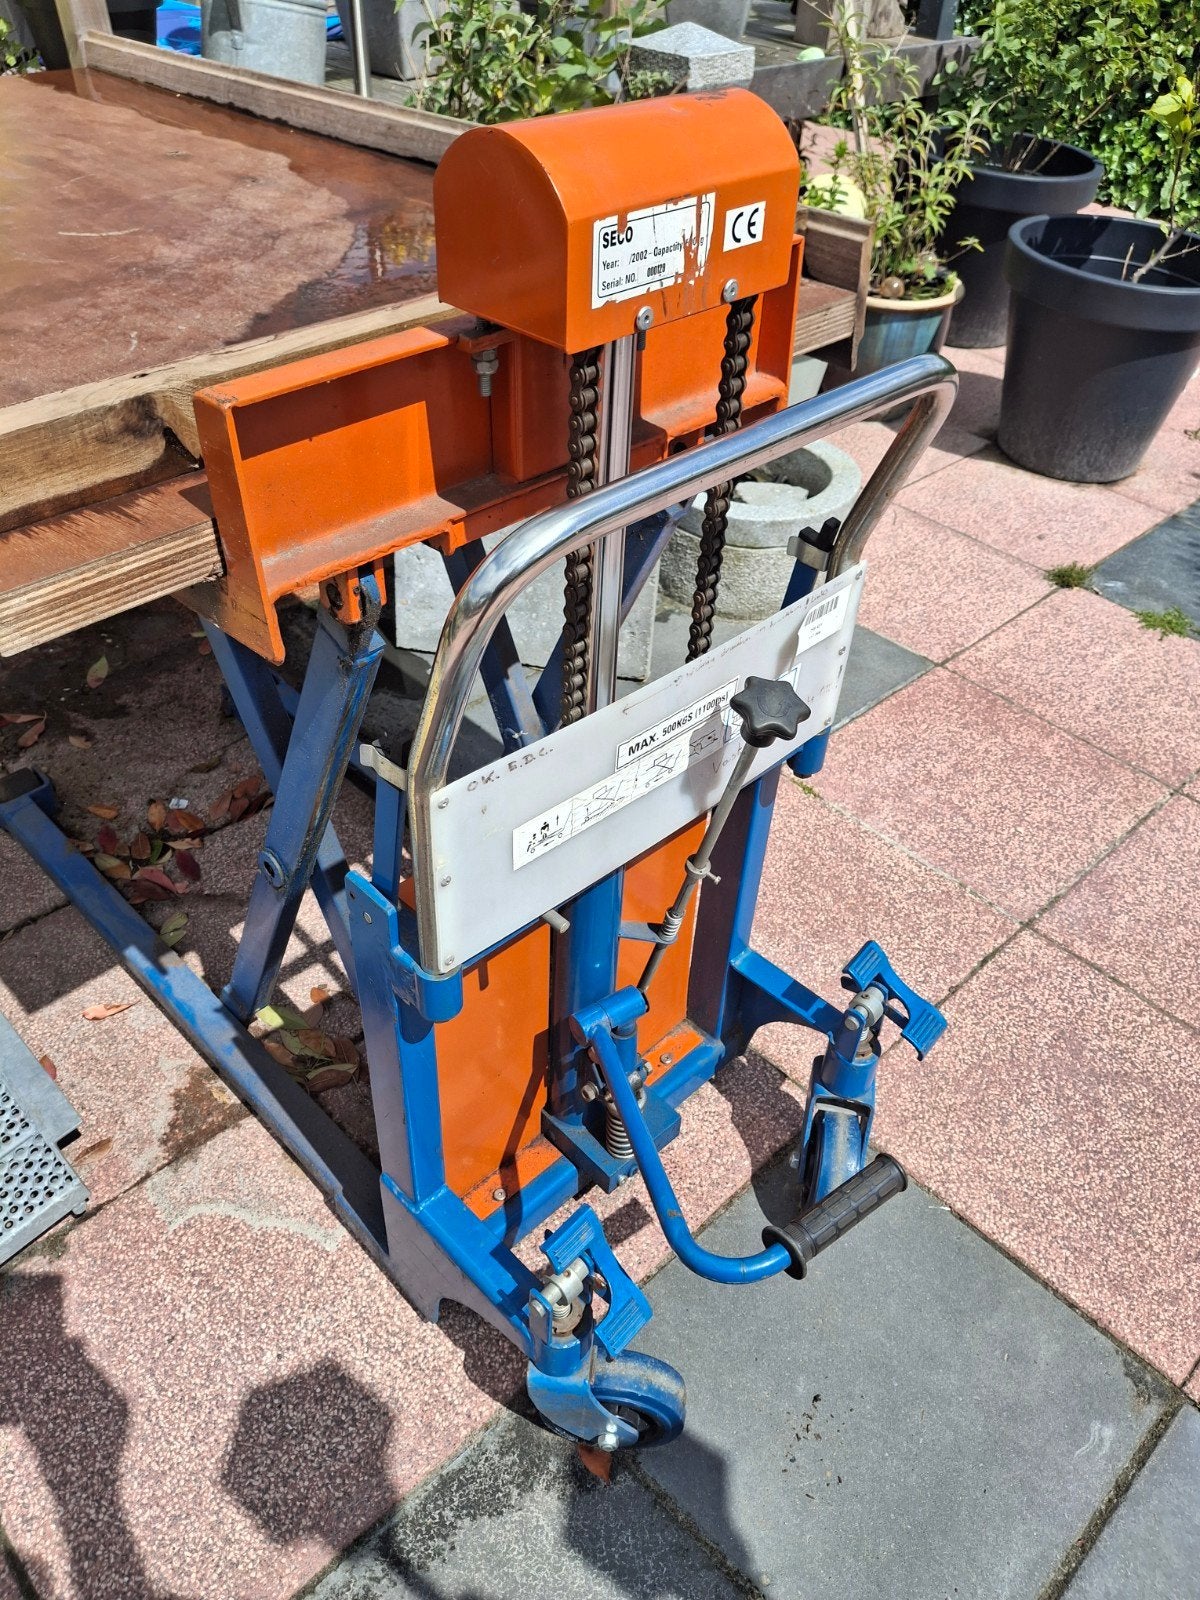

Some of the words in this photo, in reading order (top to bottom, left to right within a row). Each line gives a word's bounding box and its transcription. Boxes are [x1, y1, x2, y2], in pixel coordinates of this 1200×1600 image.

[731, 207, 760, 243] CE
[602, 259, 620, 271] Year:
[628, 733, 659, 756] MAX.
